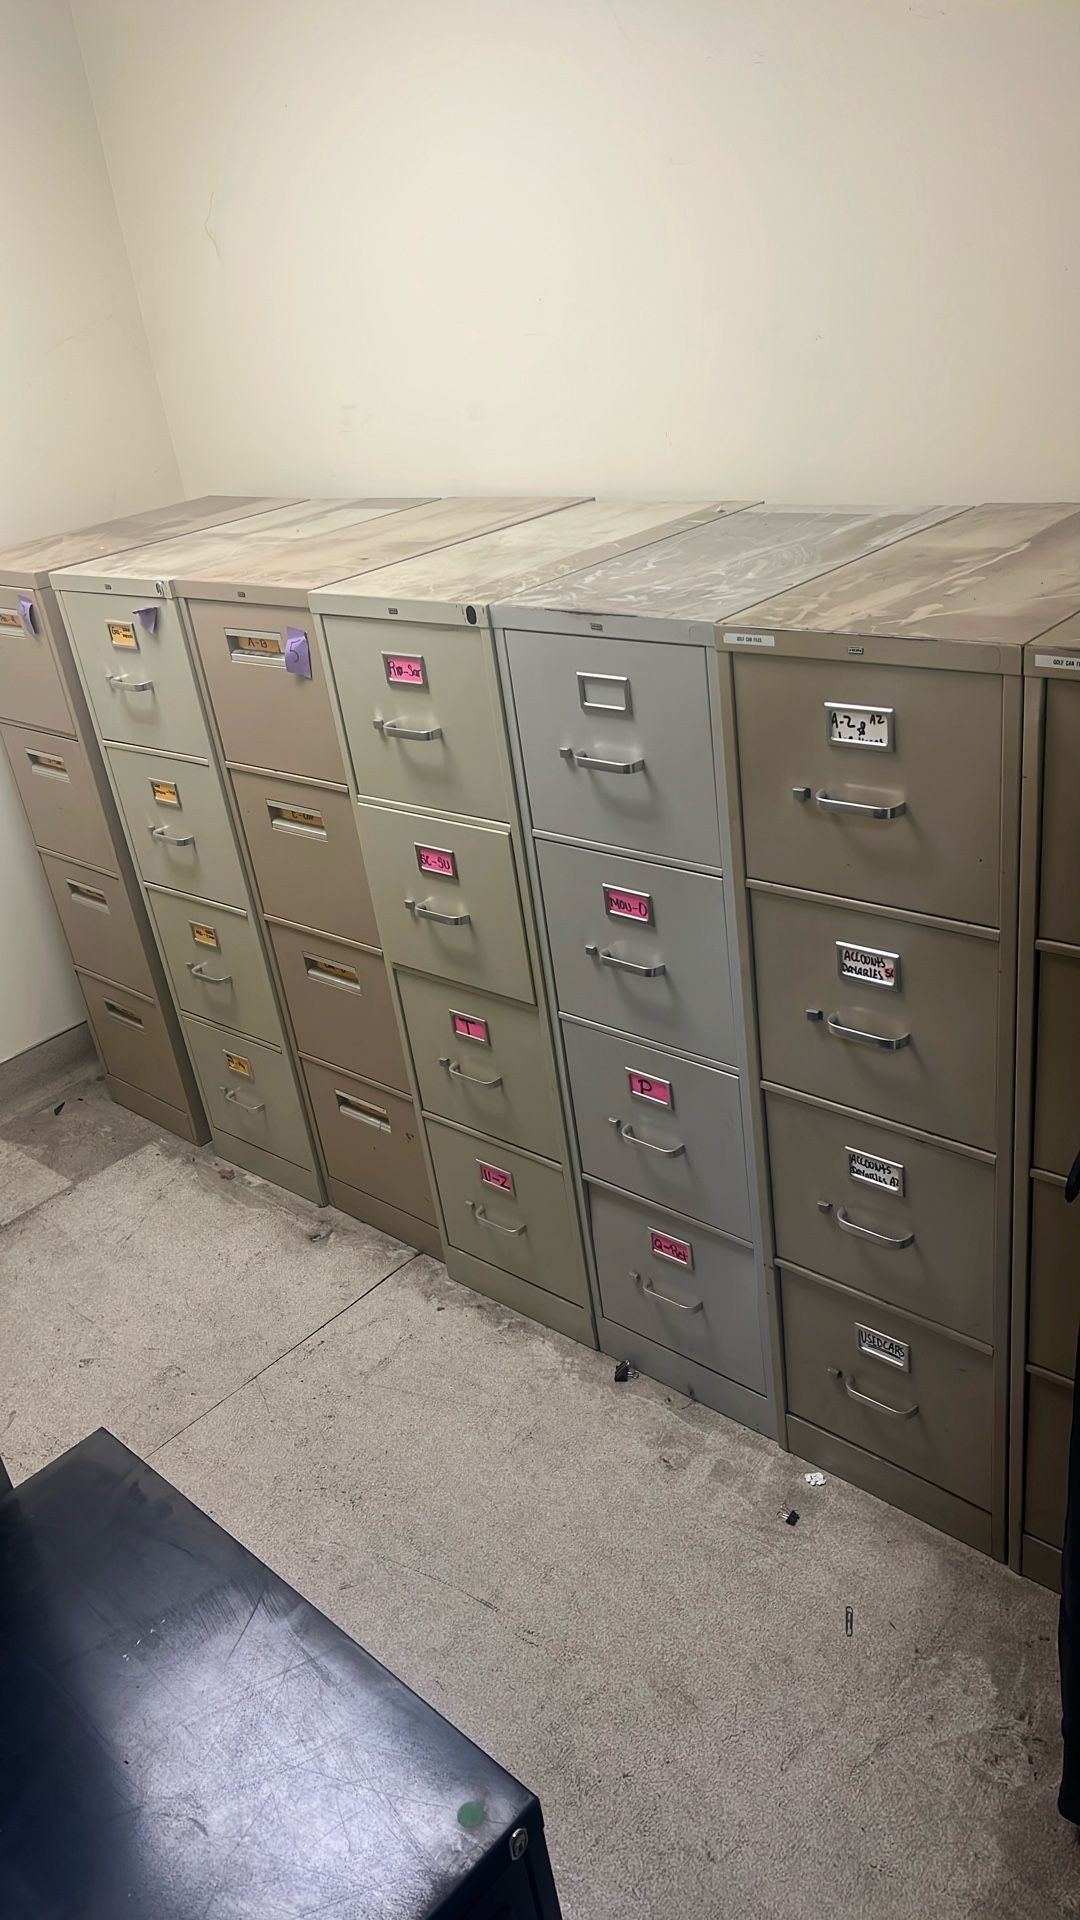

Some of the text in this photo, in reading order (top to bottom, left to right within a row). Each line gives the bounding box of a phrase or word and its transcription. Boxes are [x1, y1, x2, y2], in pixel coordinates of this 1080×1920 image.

[289, 639, 302, 663] 5
[832, 712, 856, 729] A-Z
[458, 1018, 476, 1035] T
[638, 1079, 653, 1095] P
[483, 1168, 511, 1190] U-Z
